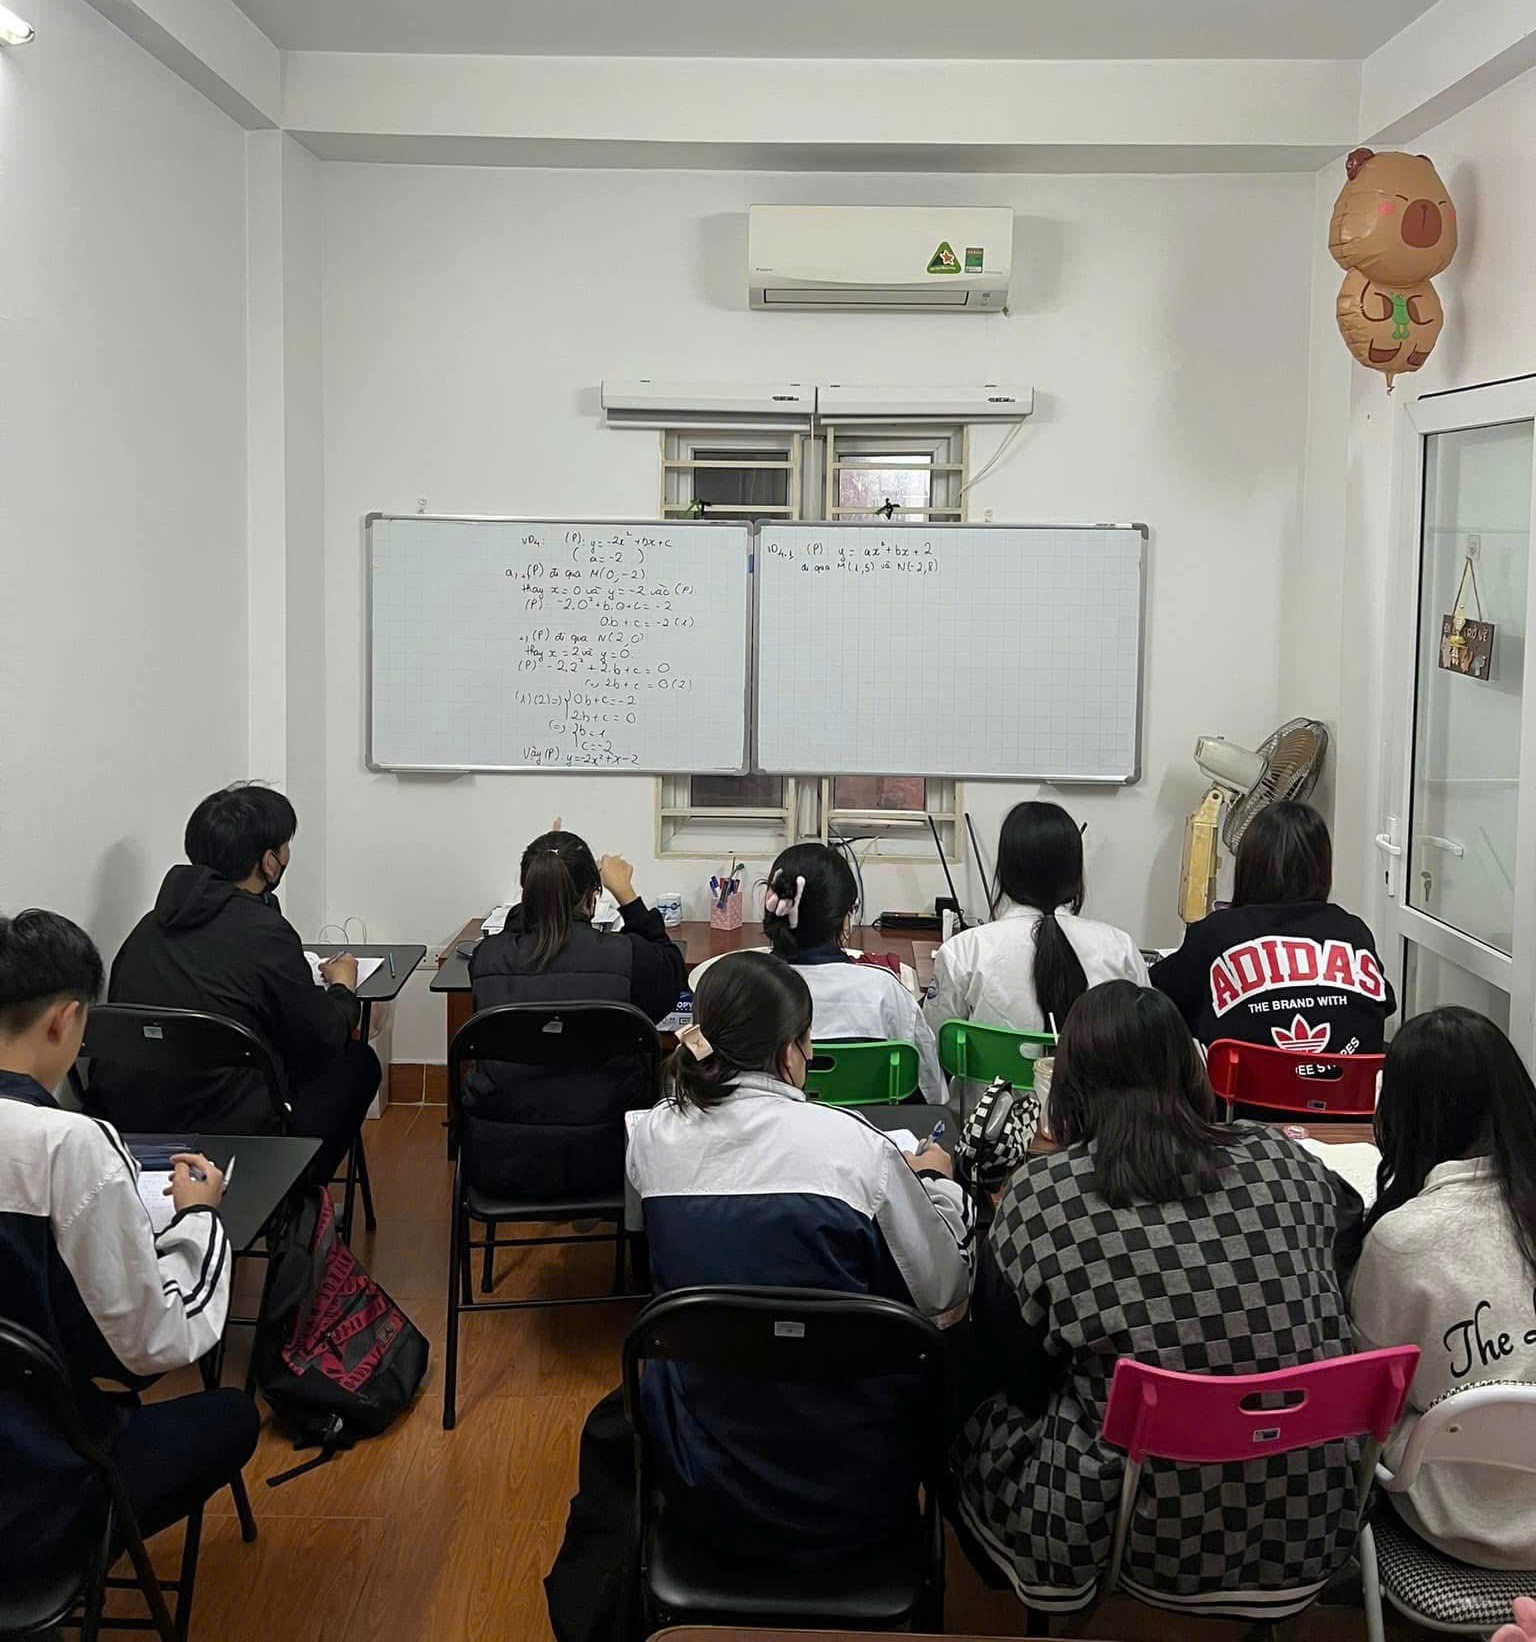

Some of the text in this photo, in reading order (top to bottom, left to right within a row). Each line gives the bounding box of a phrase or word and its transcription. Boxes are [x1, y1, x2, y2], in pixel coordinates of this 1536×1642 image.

[1210, 936, 1387, 1018] ADIDAS
[1248, 995, 1348, 1014] THE BRAND WITH
[1443, 1300, 1514, 1378] The
